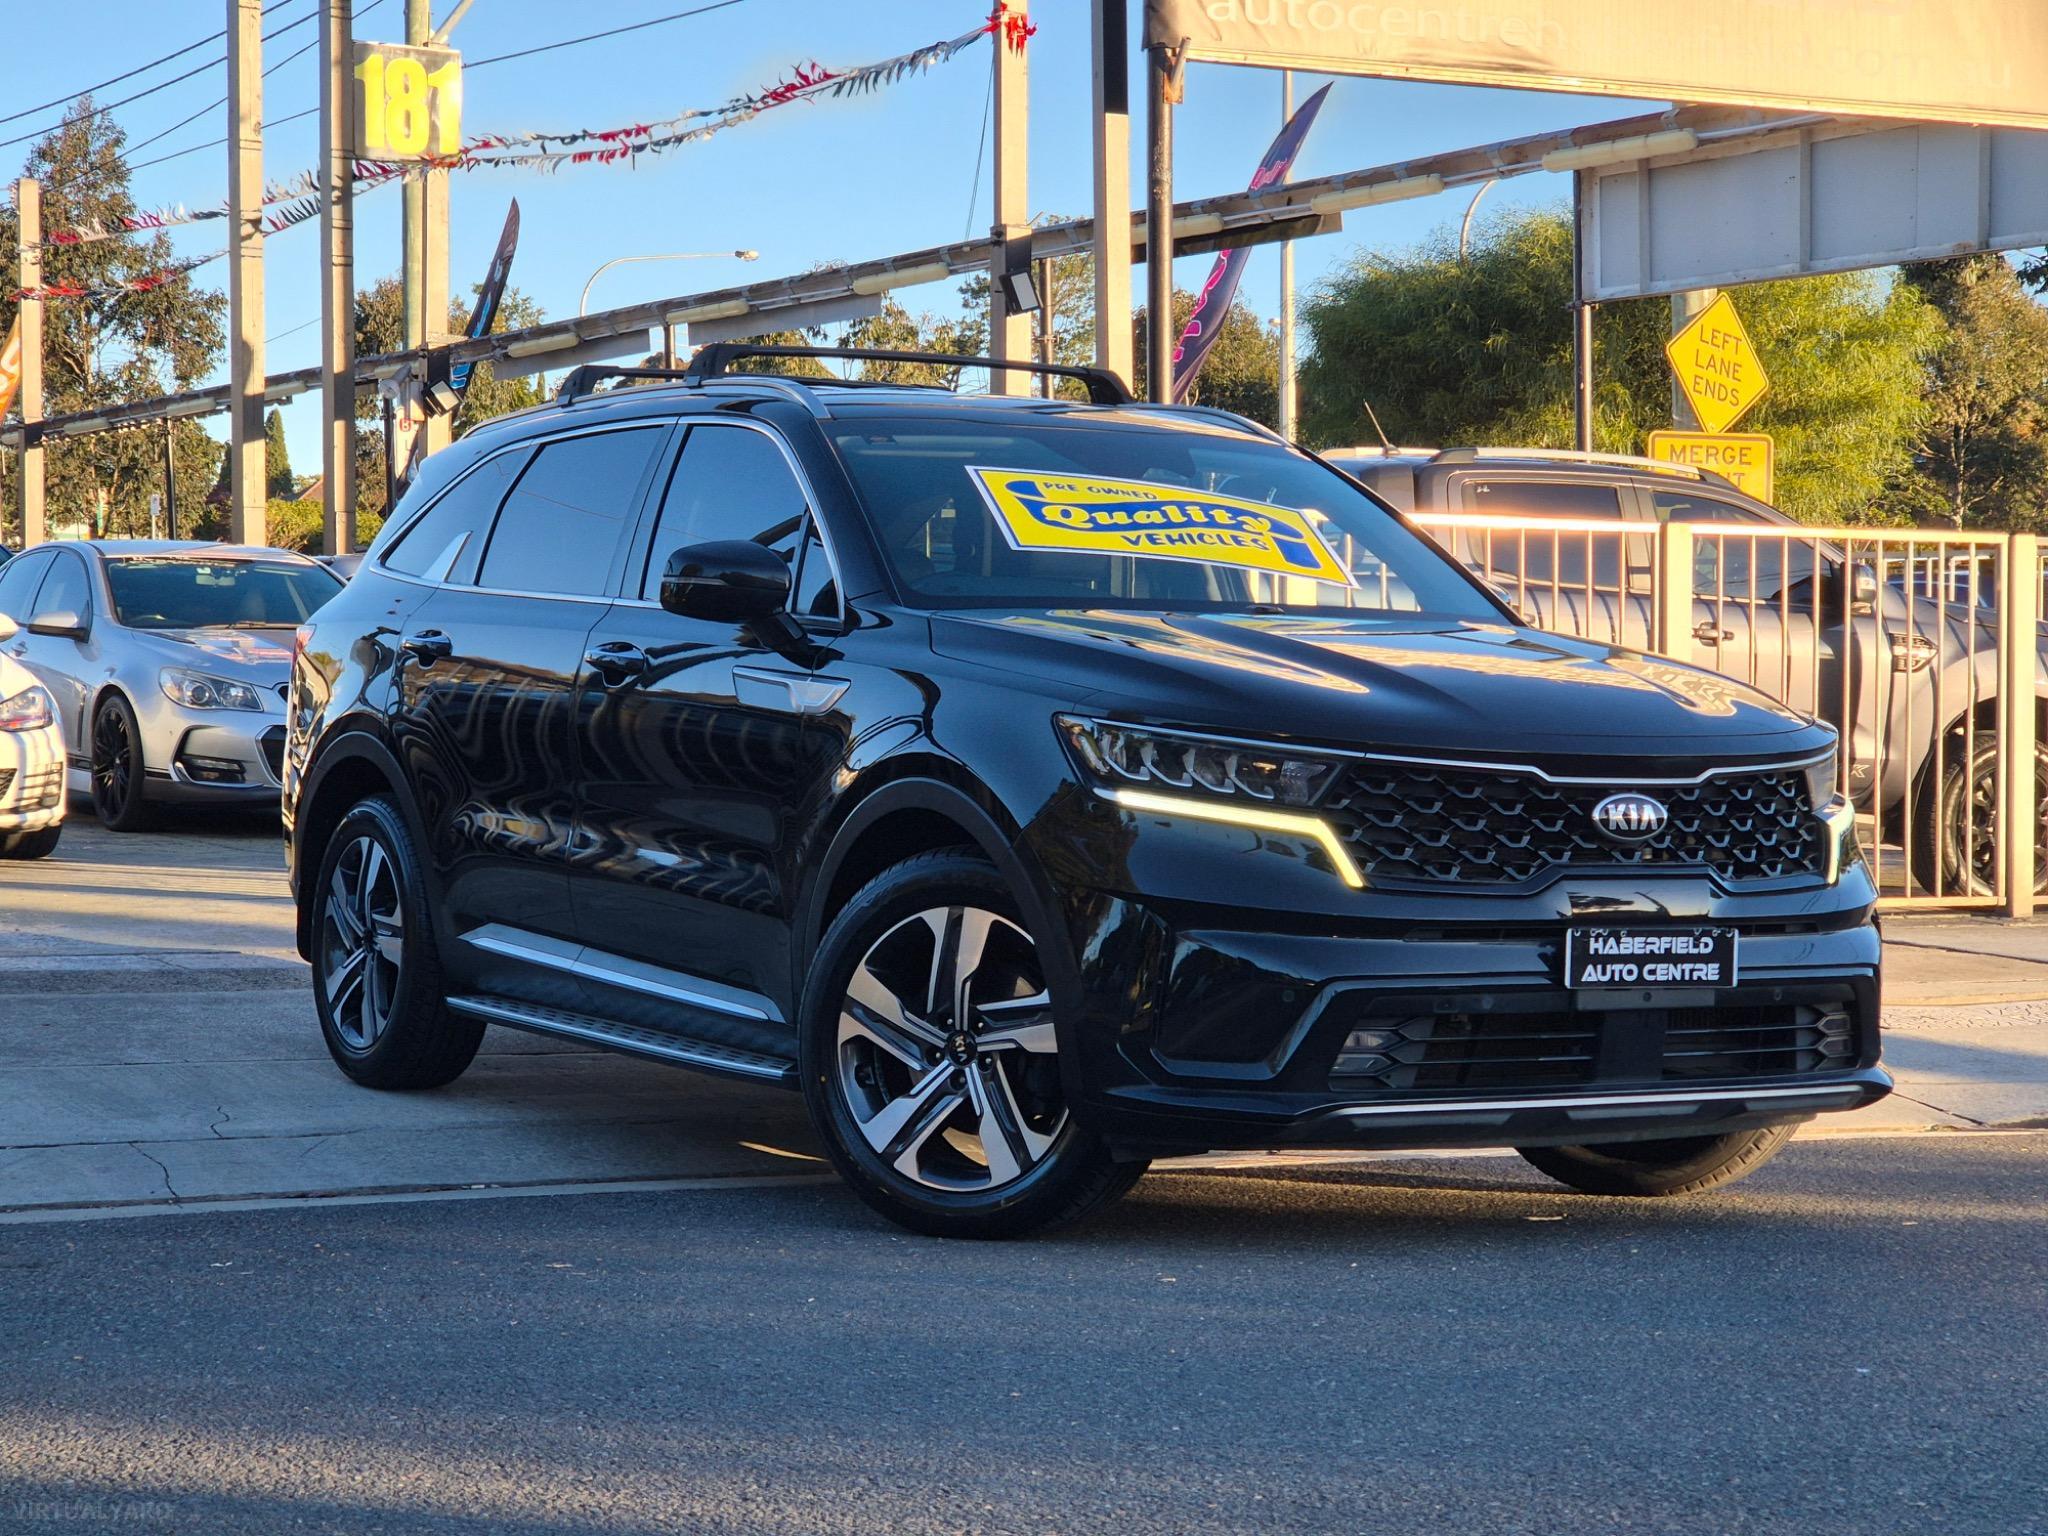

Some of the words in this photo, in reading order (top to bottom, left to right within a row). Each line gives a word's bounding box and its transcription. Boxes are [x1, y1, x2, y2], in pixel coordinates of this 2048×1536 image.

[354, 54, 460, 155] 181
[1699, 324, 1742, 356] LEFT
[1694, 348, 1742, 383] LANE
[1693, 375, 1740, 408] ENDS
[1669, 444, 1752, 465] MERGE
[1043, 482, 1079, 492] PRE
[1087, 486, 1158, 500] OWNED
[1041, 504, 1272, 537] Quality
[1120, 532, 1271, 551] VEHICLES
[1606, 803, 1659, 831] KIA
[1588, 936, 1714, 955] HABERFIELD
[1581, 963, 1639, 982] AUTO
[1642, 963, 1720, 982] CENTRE
